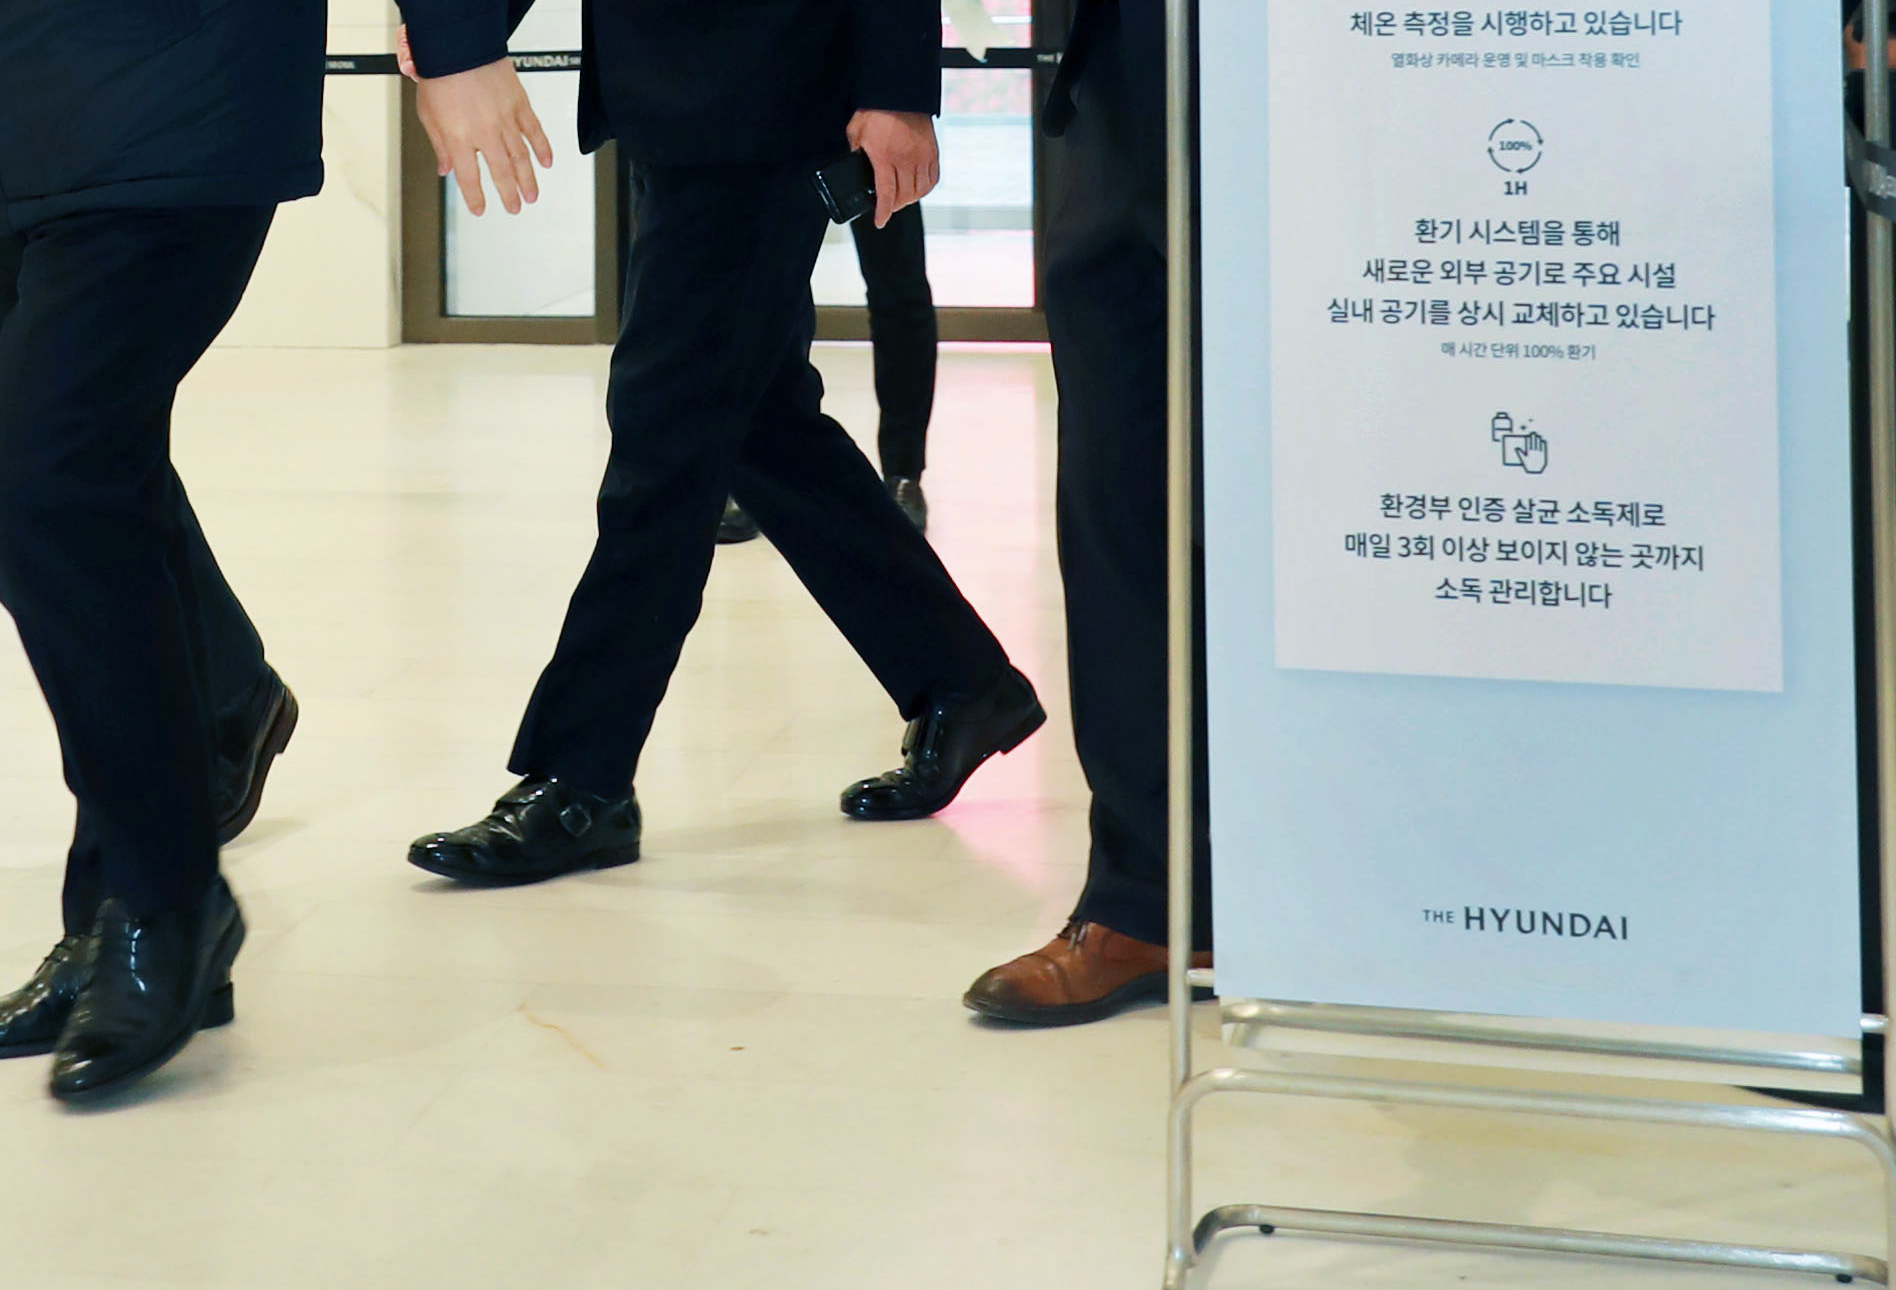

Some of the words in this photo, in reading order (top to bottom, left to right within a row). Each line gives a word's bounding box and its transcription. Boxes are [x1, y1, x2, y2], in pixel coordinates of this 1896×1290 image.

[1350, 11, 1398, 37] 체온
[1403, 10, 1475, 37] 측정을
[1480, 10, 1578, 37] 시행하고
[1583, 9, 1684, 37] 있습니다
[510, 55, 569, 68] YUNDAI
[1391, 52, 1434, 69] 열화상
[1436, 52, 1480, 68] 카메라
[1531, 52, 1576, 68] 마스크
[1578, 52, 1608, 69] 착용
[1610, 52, 1640, 69] 확인
[1499, 140, 1533, 151] 100%
[1504, 180, 1528, 196] 1H
[1415, 218, 1461, 245] 환기
[1468, 219, 1566, 247] 시스템을
[1571, 220, 1620, 247] 통해
[1362, 258, 1434, 285] 새로운
[1439, 259, 1488, 286] 외부
[1493, 260, 1567, 287] 공기로
[1572, 262, 1622, 287] 주요
[1627, 262, 1676, 289] 시설
[1327, 297, 1374, 324] 실내
[1379, 299, 1452, 326] 공기를
[1457, 300, 1504, 327] 상시
[1511, 301, 1610, 328] 교체하고
[1615, 303, 1716, 331] 있습니다
[1440, 341, 1456, 357] 매
[1458, 341, 1488, 359] 시간
[1490, 342, 1520, 359] 단위
[1523, 344, 1565, 359] 100%
[1567, 344, 1596, 361] 환기
[1380, 493, 1452, 521] 환경부
[1458, 496, 1507, 523] 인증
[1512, 498, 1561, 525] 살균
[1566, 501, 1666, 528] 소독제로
[1344, 532, 1391, 559] 매일
[1397, 534, 1435, 561] 3회
[1442, 535, 1491, 563] 이상
[1495, 539, 1568, 567] 보이지
[1574, 541, 1625, 568] 않는
[1629, 543, 1704, 572] 곳까지
[1435, 577, 1483, 604] 소독
[1488, 578, 1613, 609] 관리합니다
[1422, 909, 1454, 924] THE
[1464, 906, 1628, 941] HYUNDAI
